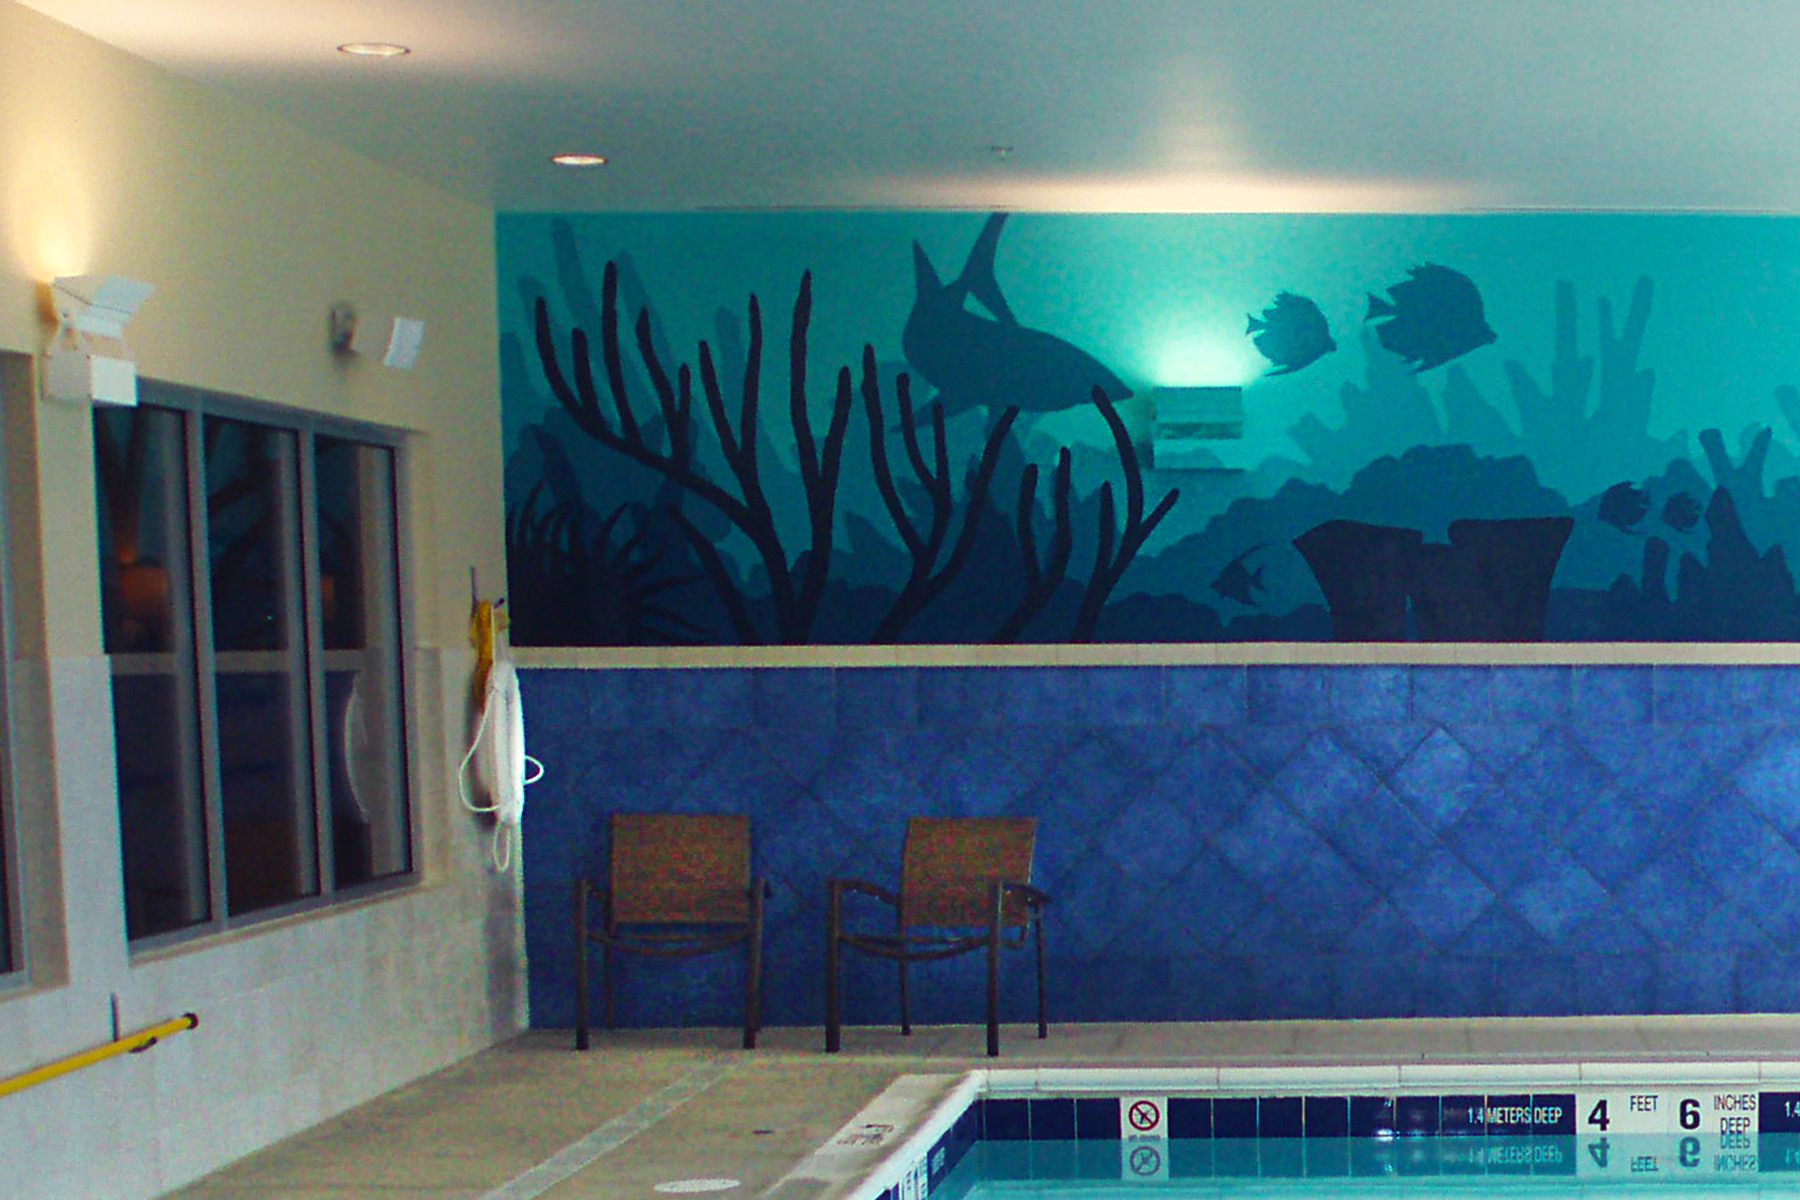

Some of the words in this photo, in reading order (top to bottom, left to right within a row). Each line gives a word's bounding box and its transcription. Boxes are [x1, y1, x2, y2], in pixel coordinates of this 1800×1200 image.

[1486, 1107, 1532, 1124] METERS
[1534, 1107, 1562, 1124] DEEP
[1588, 1099, 1610, 1131] 4
[1630, 1095, 1658, 1112] FEET
[1679, 1098, 1700, 1130] 6
[1714, 1094, 1757, 1111] INCHES
[1720, 1117, 1751, 1136] DEEP
